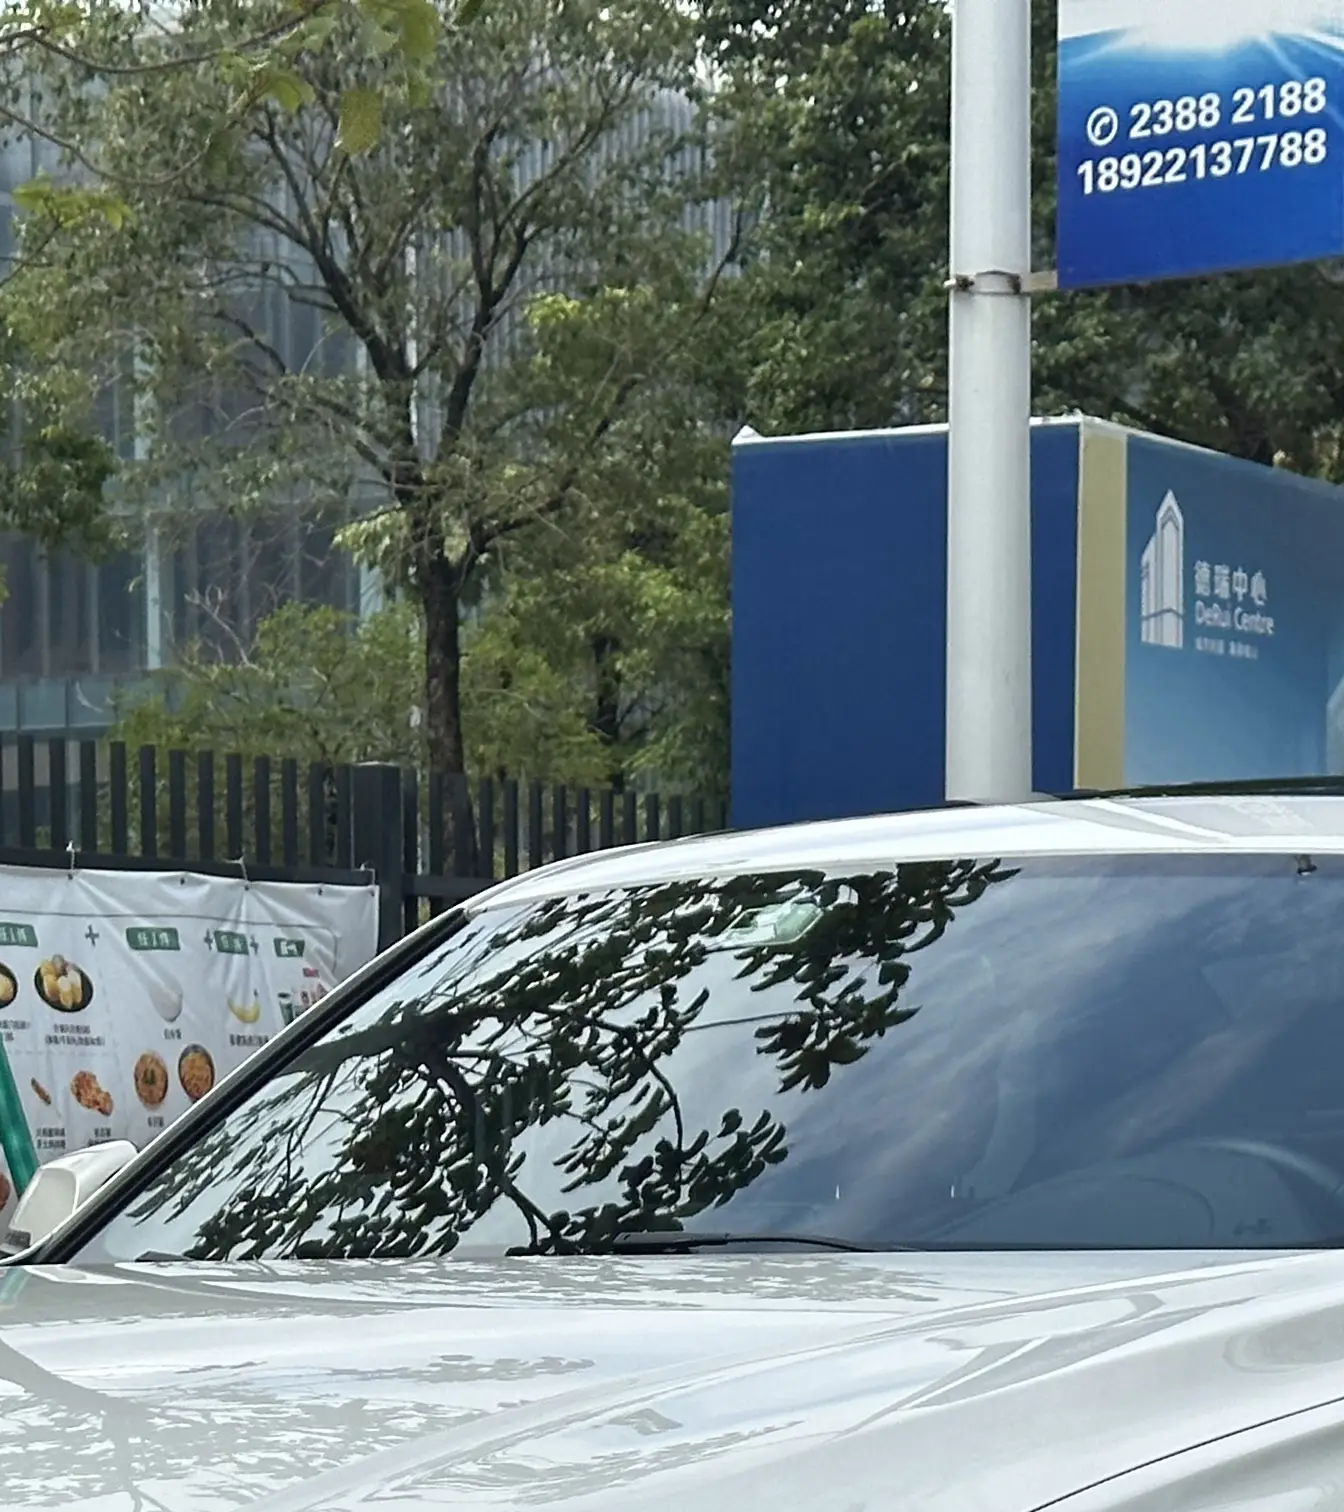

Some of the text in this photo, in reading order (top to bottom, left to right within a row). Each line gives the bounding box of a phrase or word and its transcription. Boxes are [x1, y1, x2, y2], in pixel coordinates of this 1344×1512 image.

[1128, 77, 1327, 139] 2388 2188
[1077, 128, 1327, 195] 18922137788
